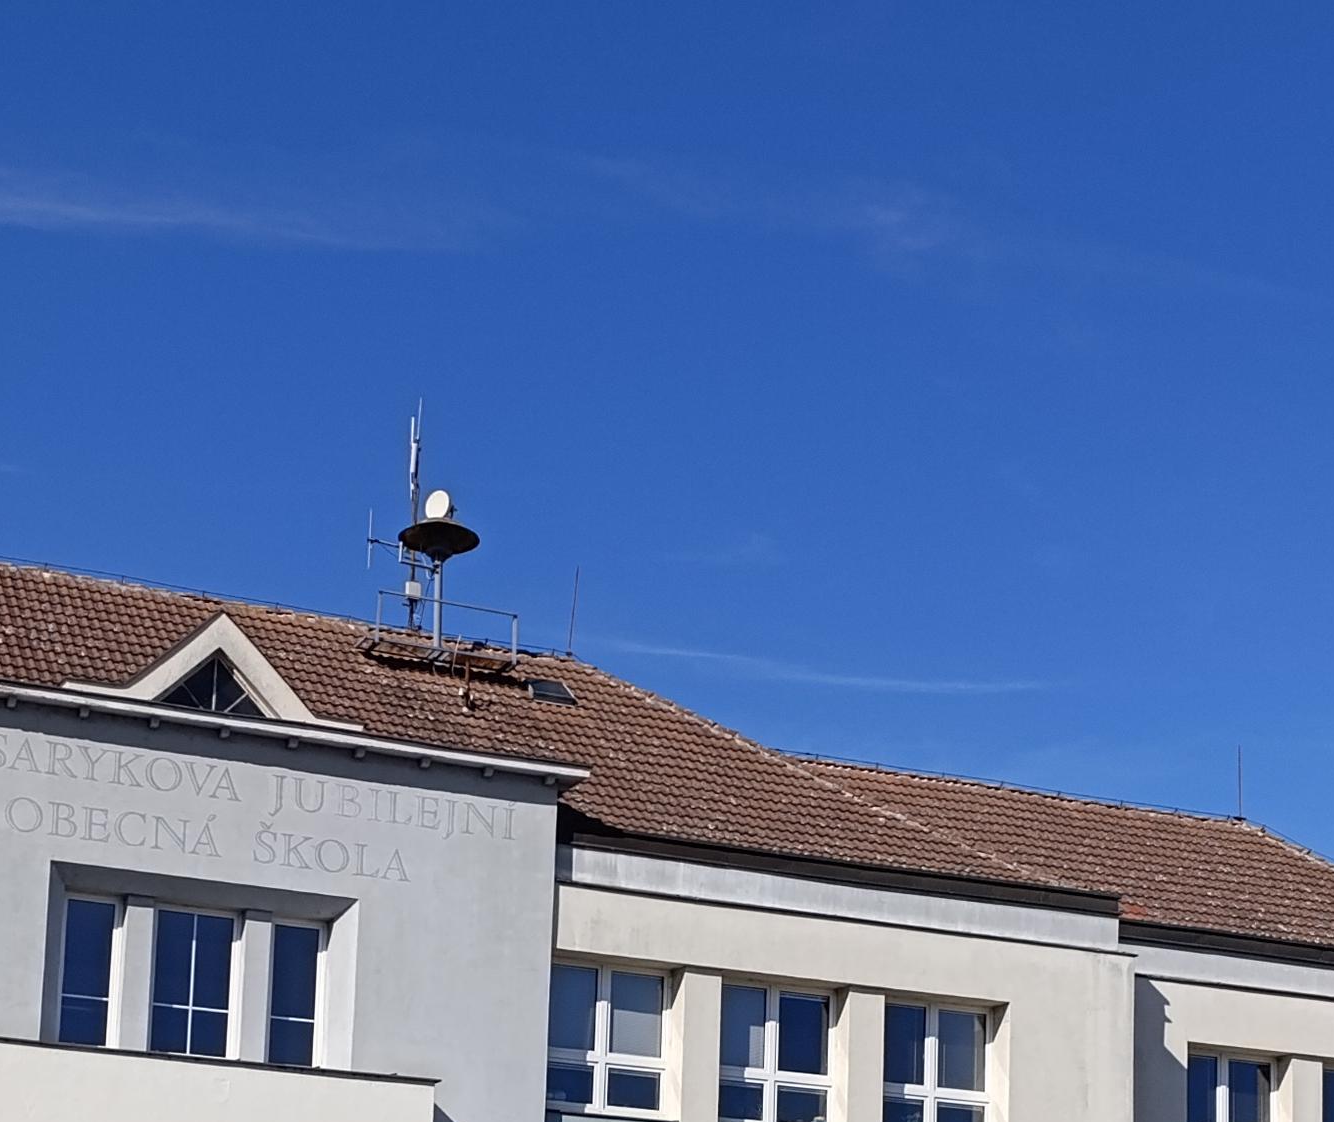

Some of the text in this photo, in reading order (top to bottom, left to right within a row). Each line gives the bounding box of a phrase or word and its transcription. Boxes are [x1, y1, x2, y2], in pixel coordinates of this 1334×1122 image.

[4, 796, 410, 882] OBECNÁ ŠKOLA
[269, 774, 517, 841] JUBILEJNÍ
